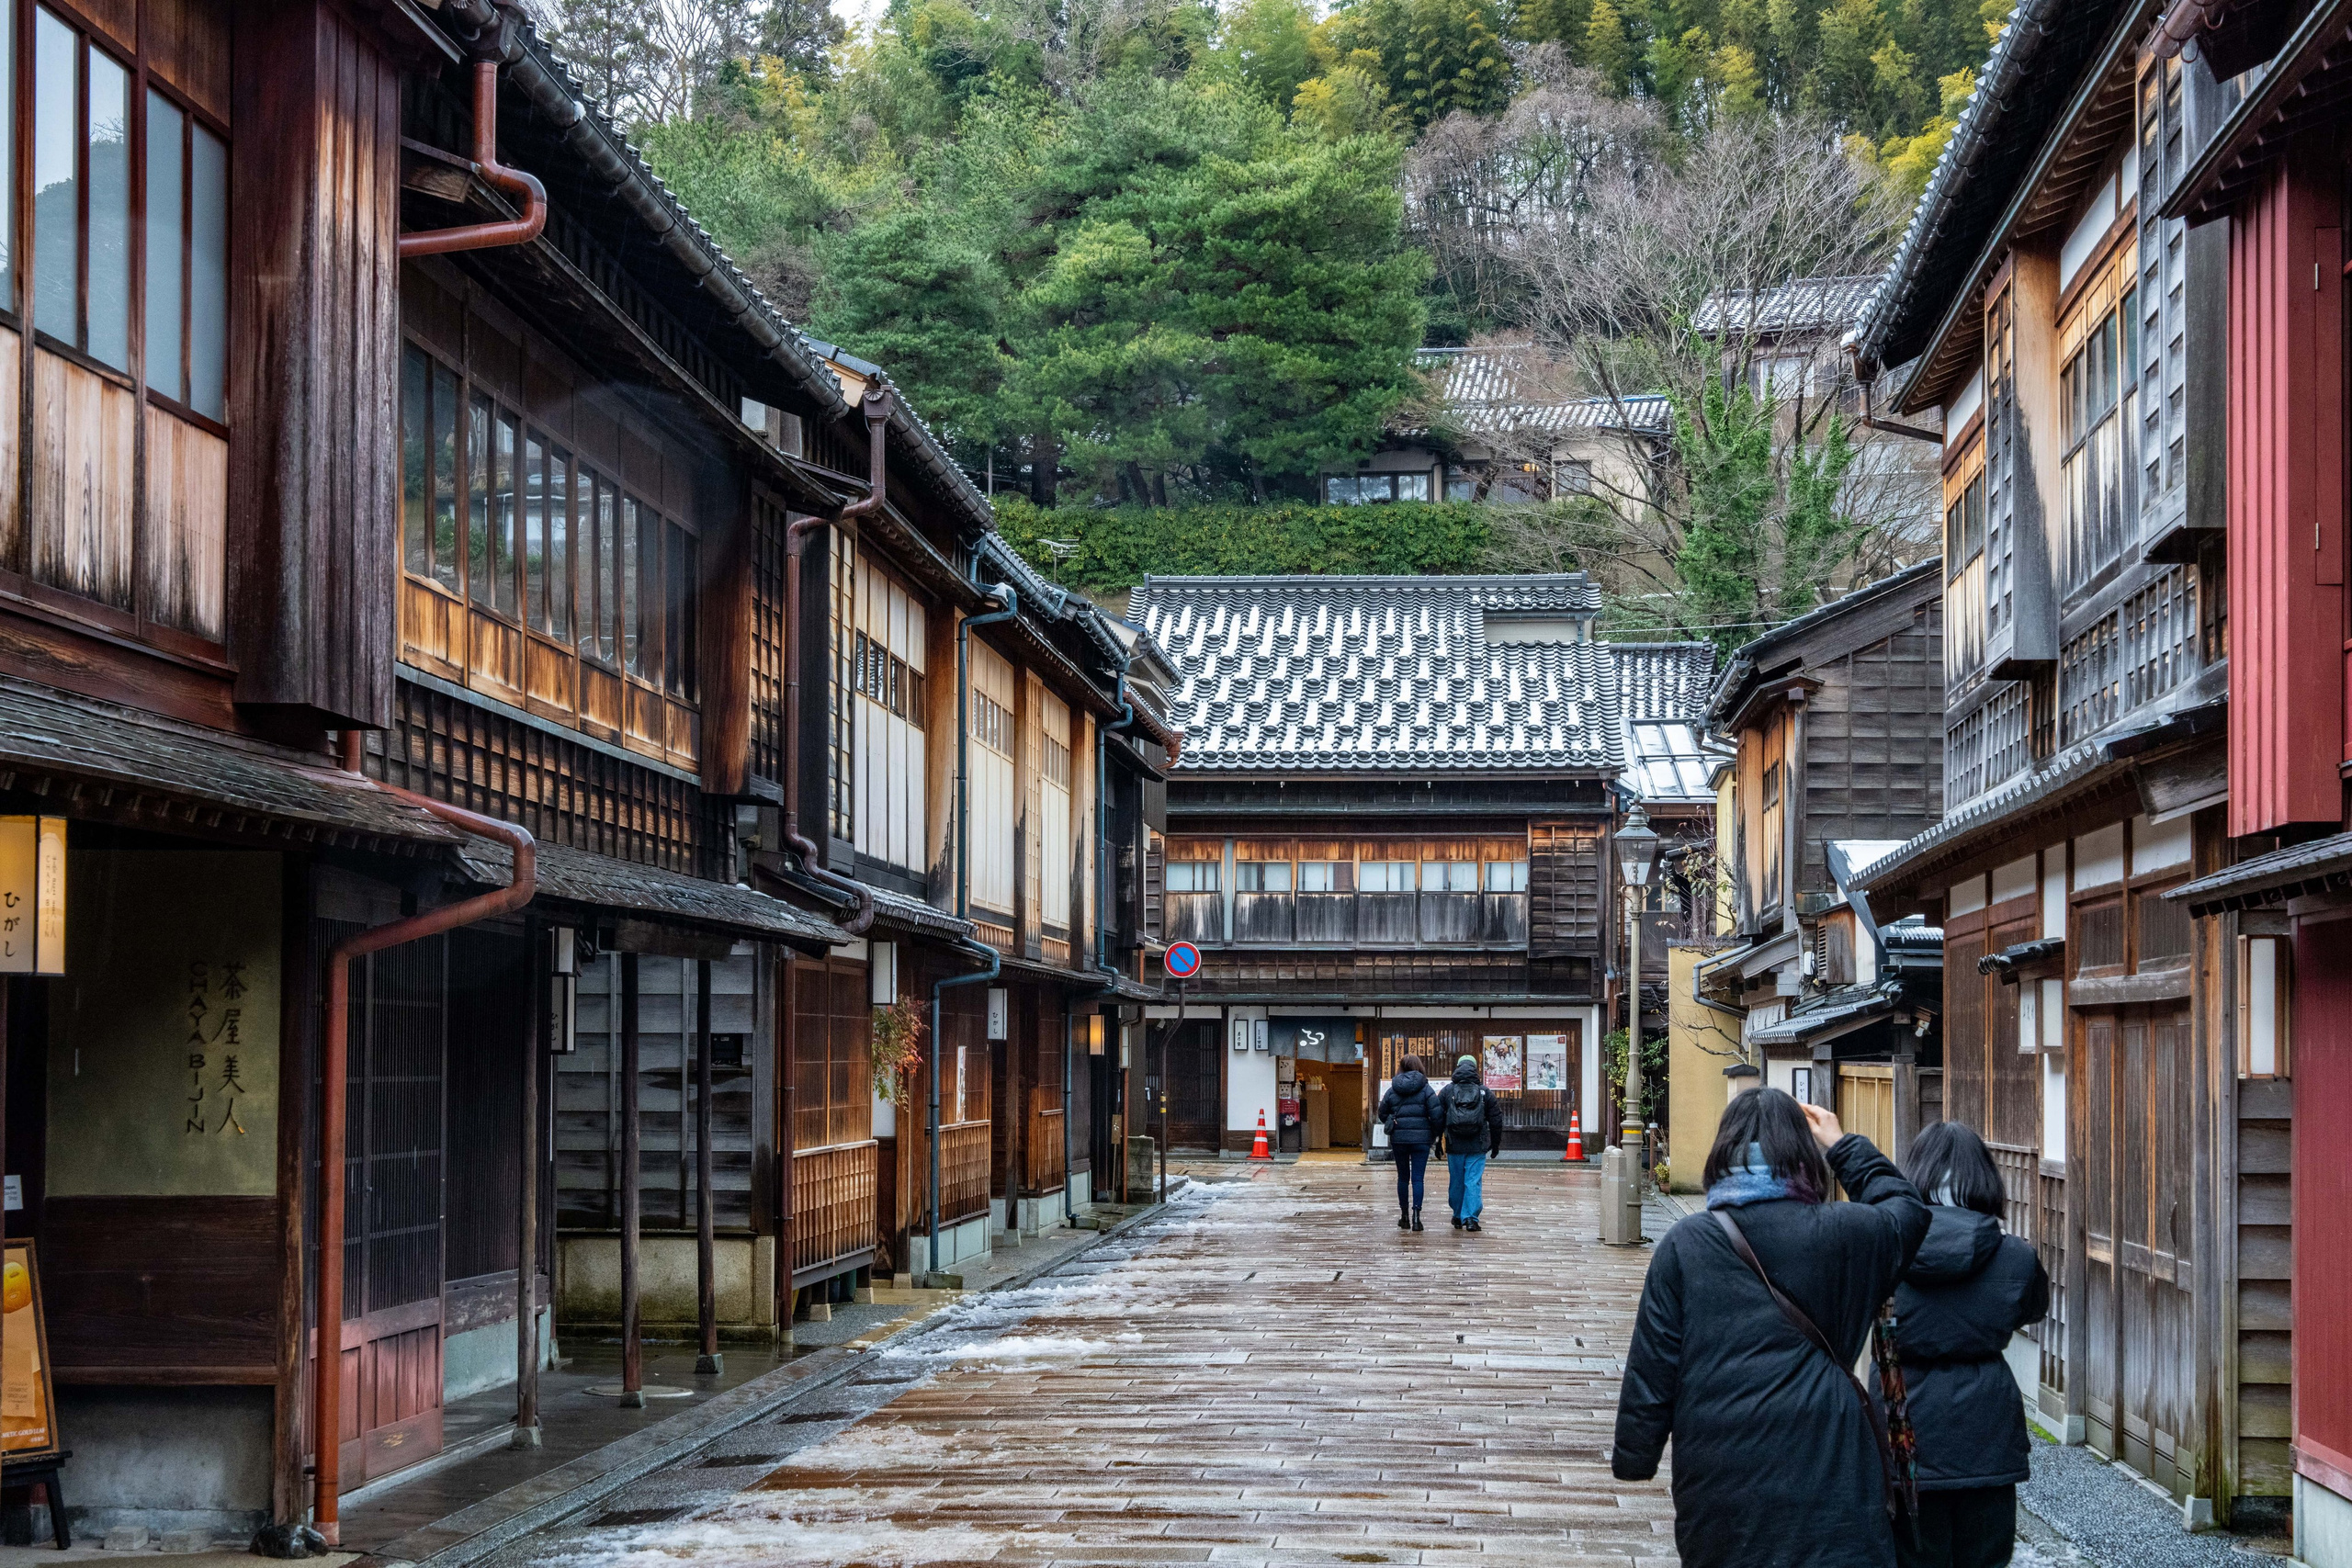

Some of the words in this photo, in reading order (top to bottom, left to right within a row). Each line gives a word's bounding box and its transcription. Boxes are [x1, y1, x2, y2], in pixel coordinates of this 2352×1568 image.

[4, 891, 20, 957] ひがし
[187, 962, 208, 1045] CHAYA
[211, 961, 248, 1135] 茶屋美人
[187, 1054, 206, 1134] BIJIN
